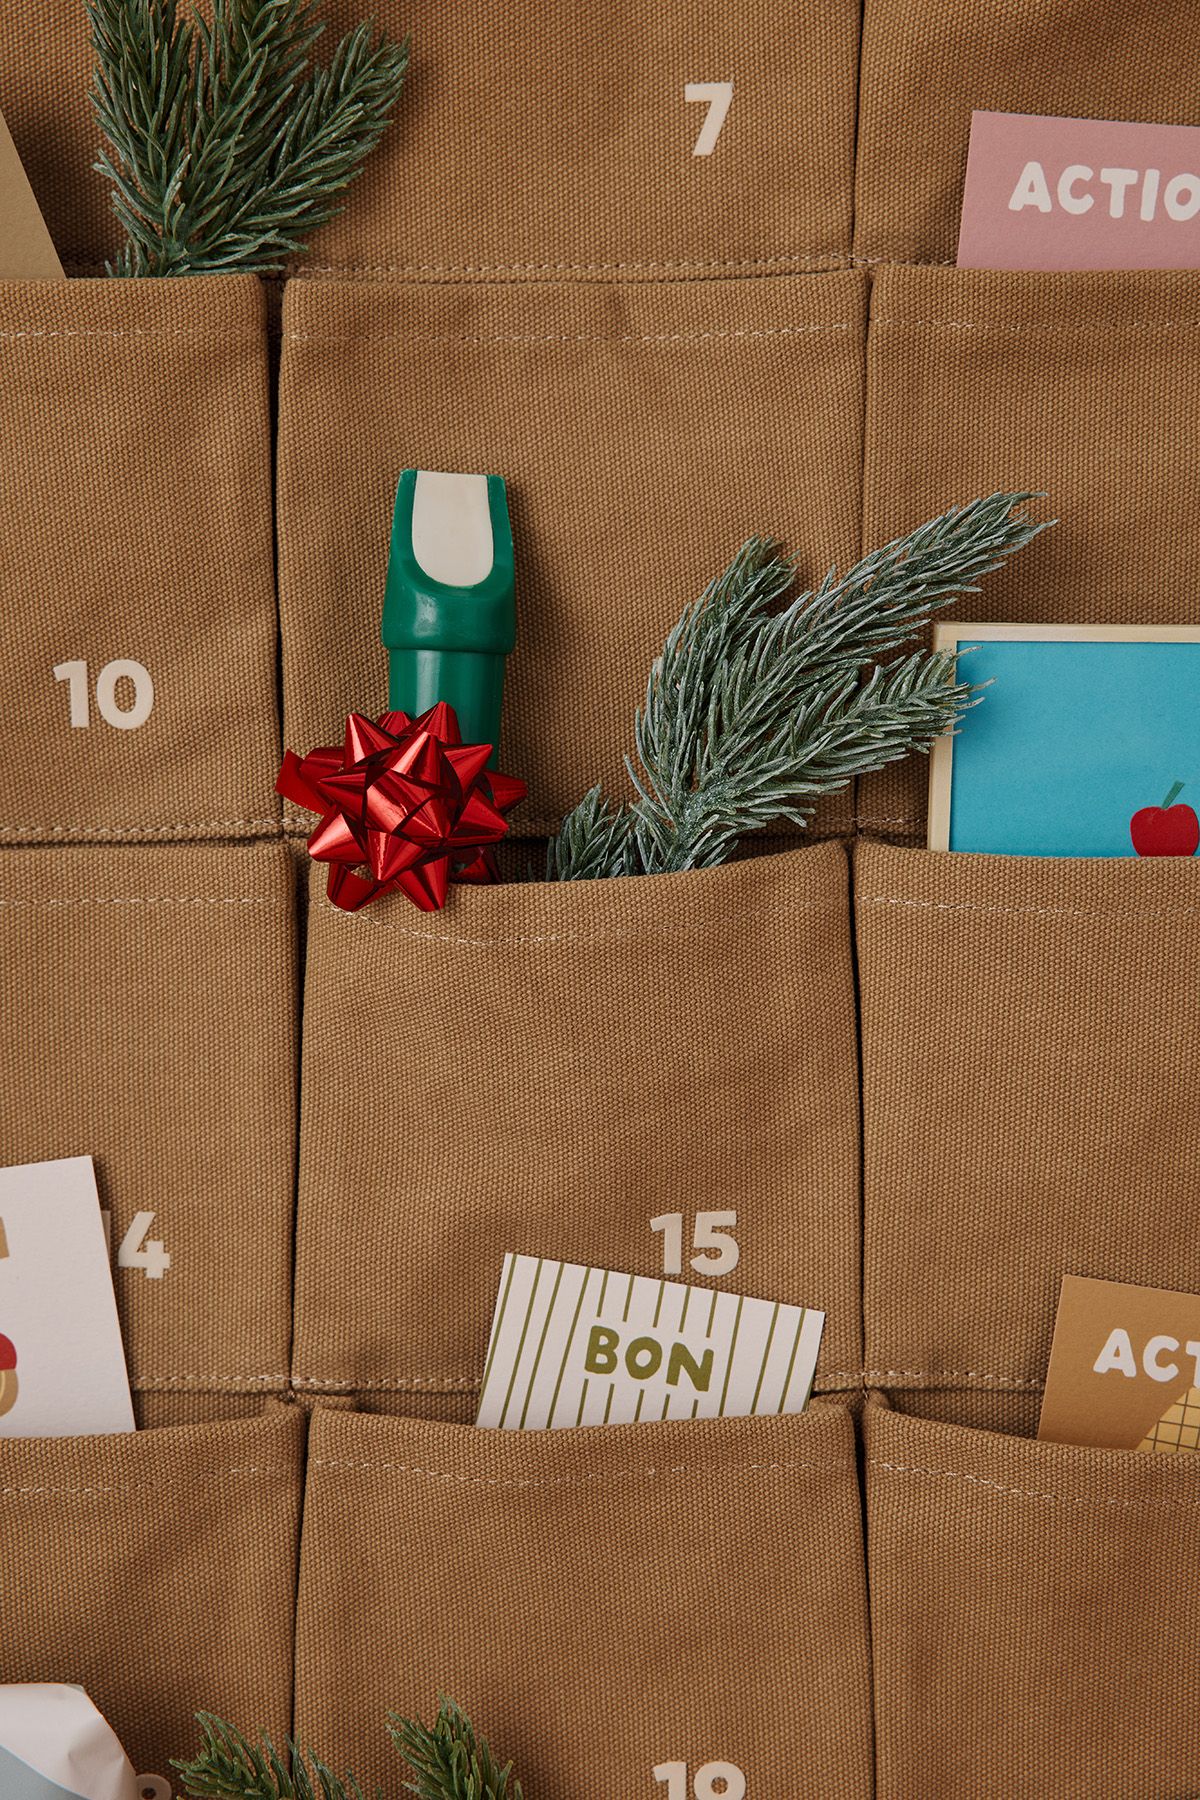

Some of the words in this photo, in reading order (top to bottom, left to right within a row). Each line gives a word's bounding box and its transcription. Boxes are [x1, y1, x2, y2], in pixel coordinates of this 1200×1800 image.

[684, 81, 734, 156] 7
[53, 659, 155, 730] 10
[101, 1209, 171, 1279] 4
[650, 1210, 740, 1276] 15
[584, 1325, 714, 1392] BON
